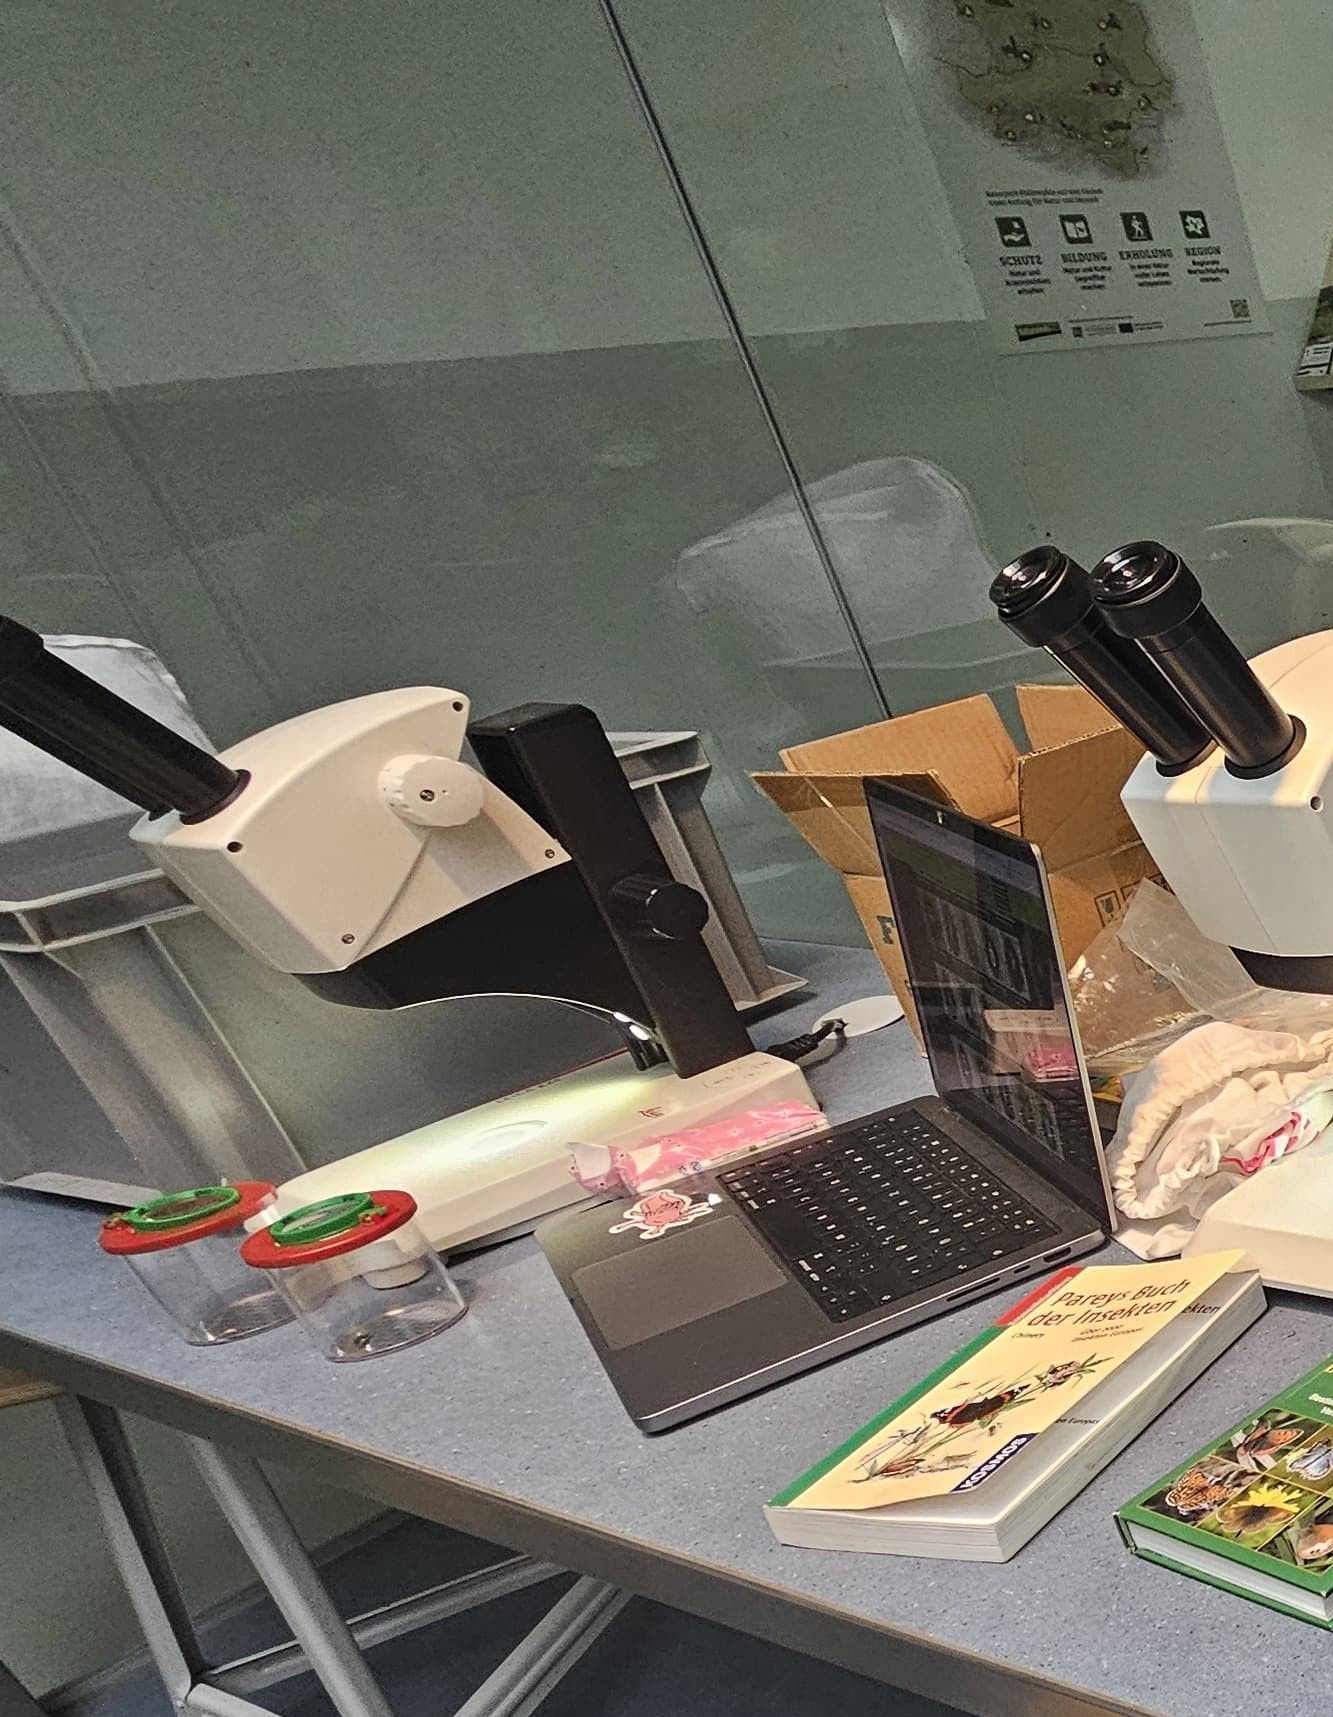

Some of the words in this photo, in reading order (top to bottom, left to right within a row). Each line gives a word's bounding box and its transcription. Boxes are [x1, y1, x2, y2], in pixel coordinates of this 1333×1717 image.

[1000, 255, 1043, 267] SCHUTZ
[1049, 1288, 1128, 1309] Pareys
[1131, 1279, 1192, 1299] Buch
[1027, 1309, 1072, 1327] der
[1072, 1299, 1179, 1325] Insekten
[1181, 1302, 1223, 1315] ekten
[959, 1435, 1027, 1488] KOSMOS
